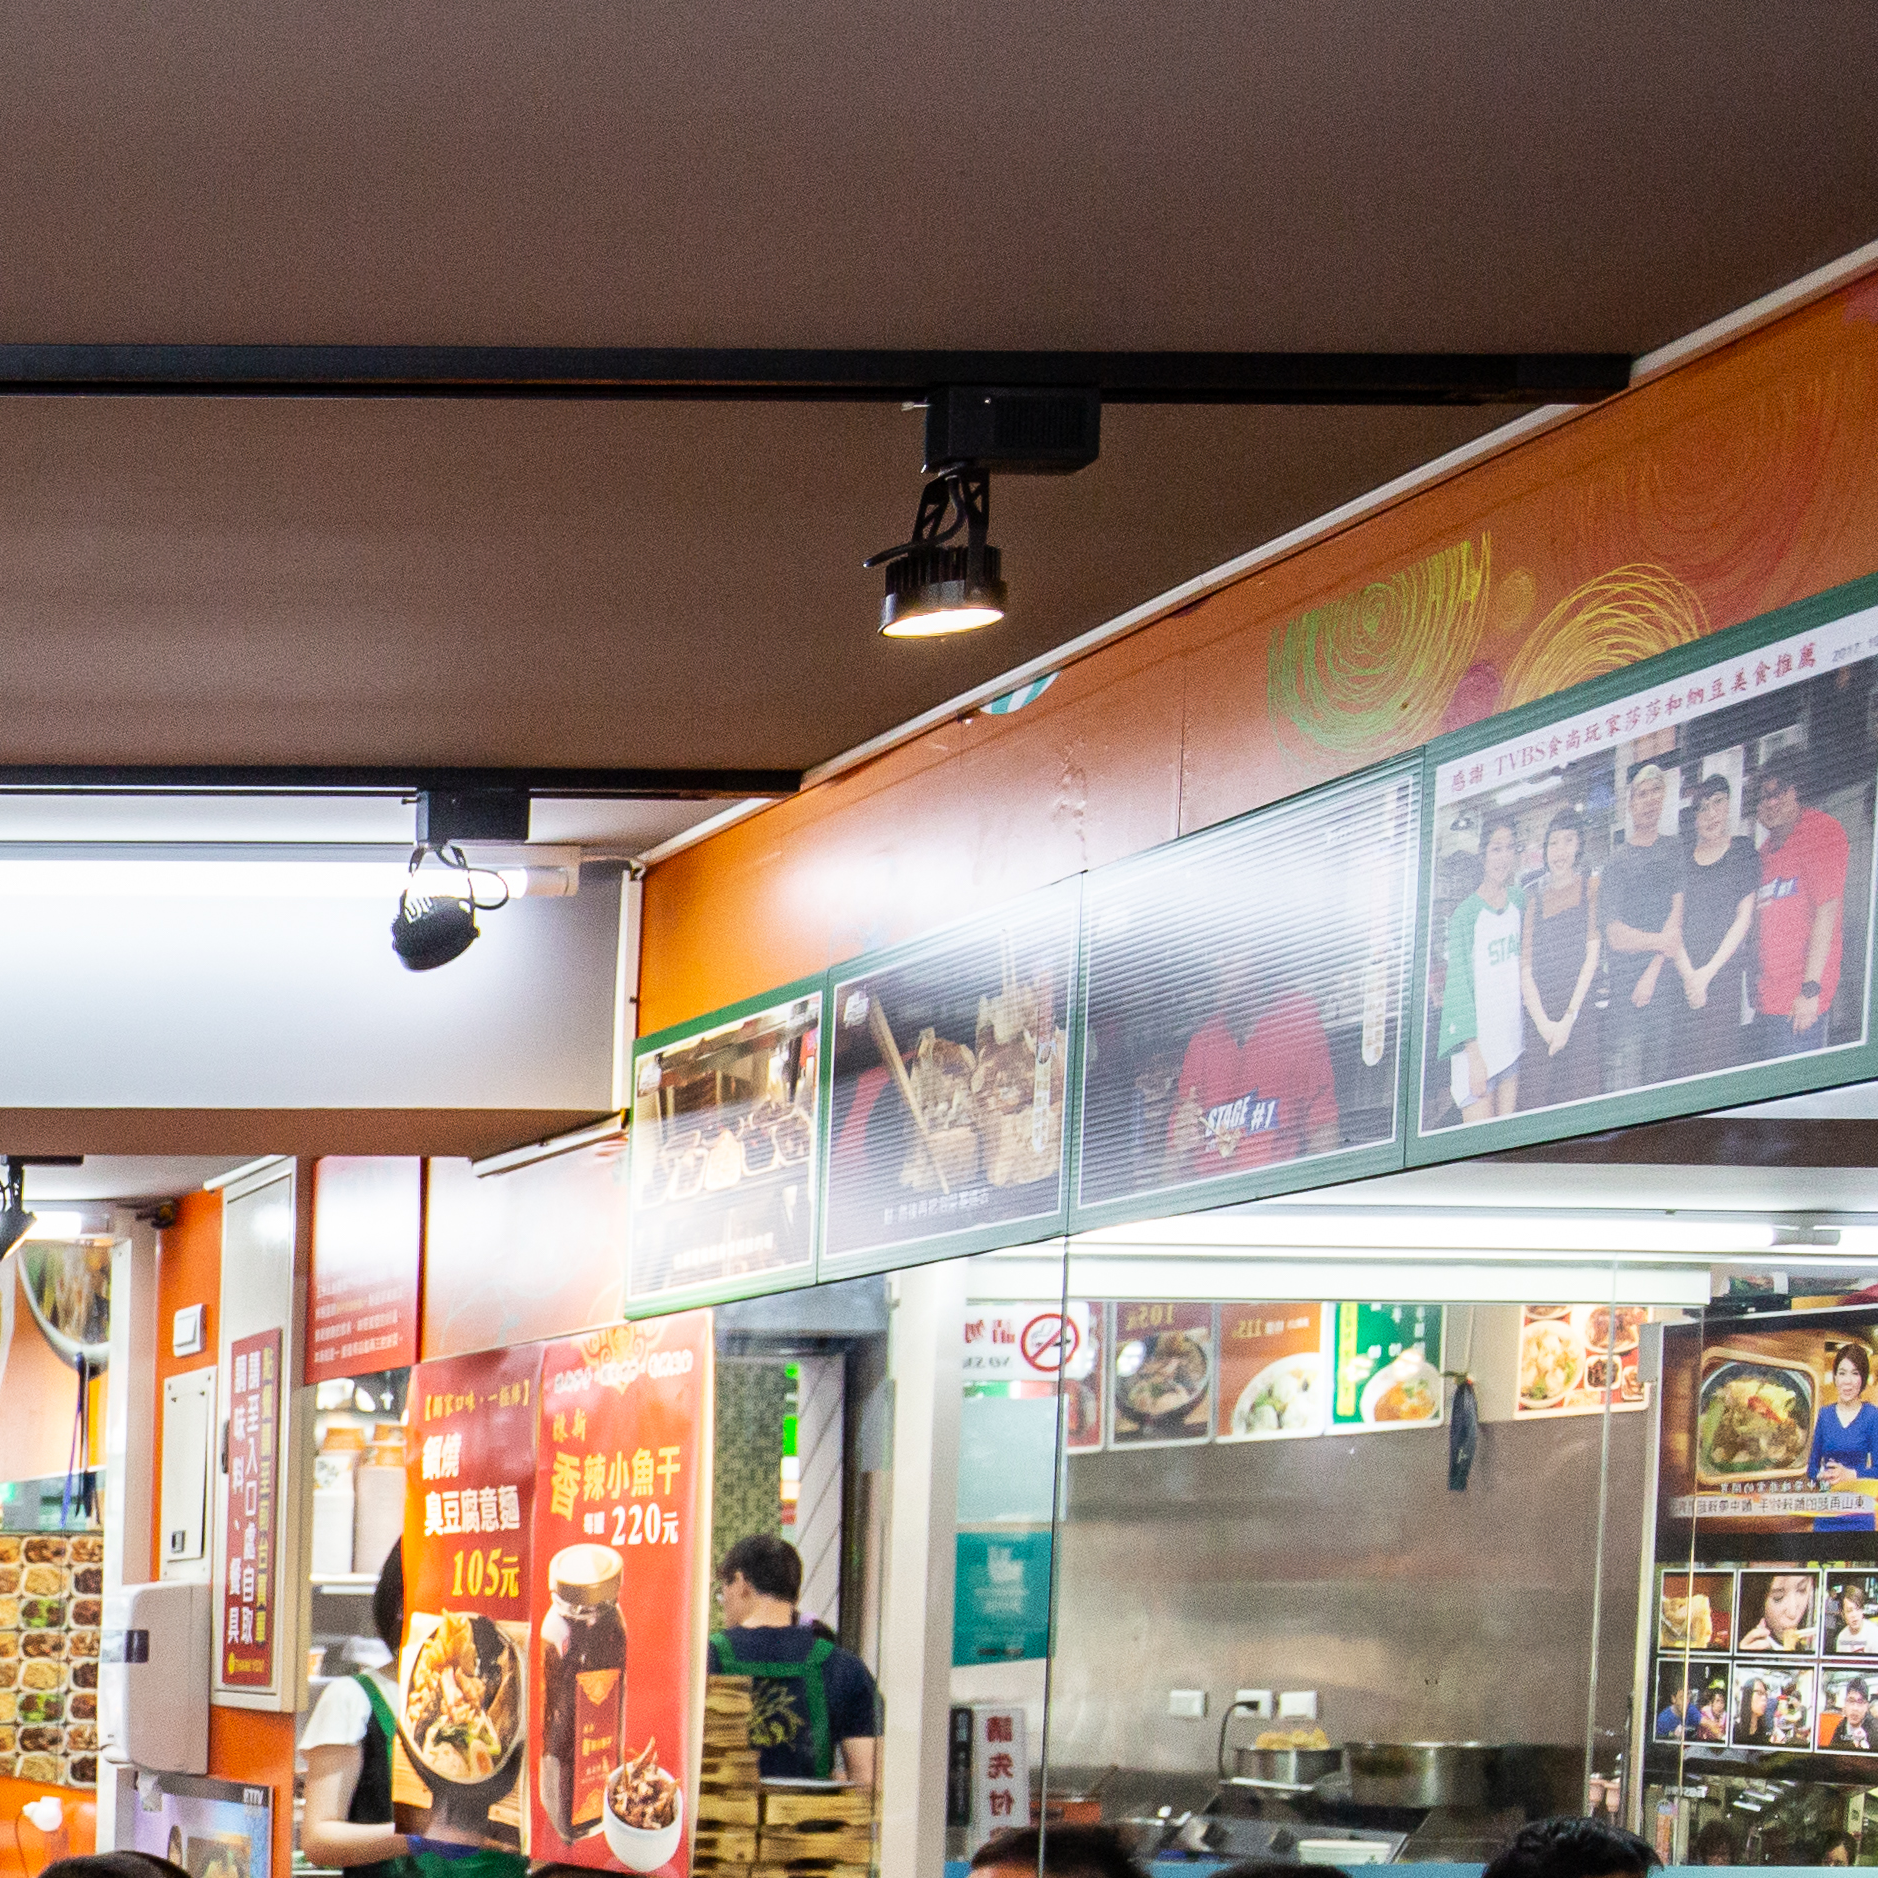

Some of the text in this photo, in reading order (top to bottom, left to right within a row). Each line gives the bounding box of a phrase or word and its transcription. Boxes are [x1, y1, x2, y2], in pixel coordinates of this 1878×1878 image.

[549, 1444, 681, 1522] 香辣小魚干
[424, 1484, 521, 1537] 臭豆腐意麵
[610, 1502, 680, 1547] 220元
[450, 1547, 521, 1598] 105元
